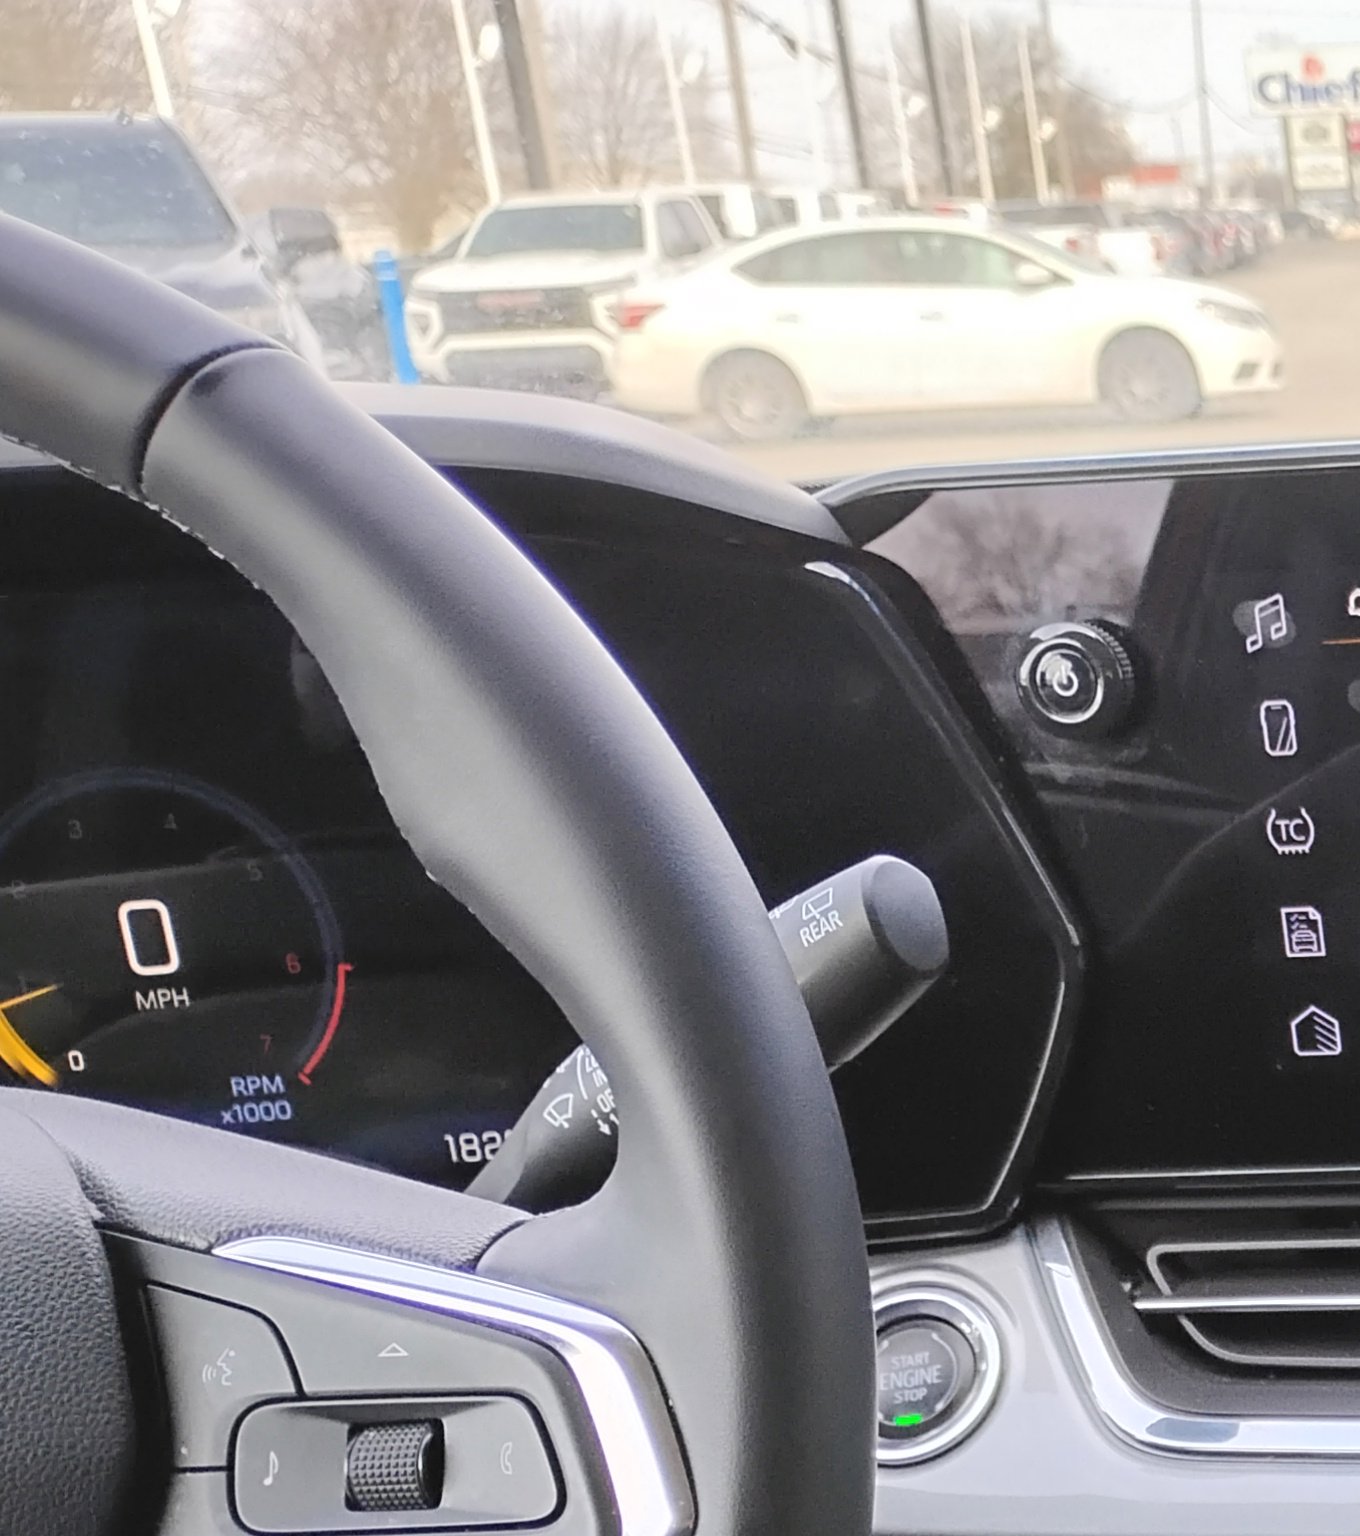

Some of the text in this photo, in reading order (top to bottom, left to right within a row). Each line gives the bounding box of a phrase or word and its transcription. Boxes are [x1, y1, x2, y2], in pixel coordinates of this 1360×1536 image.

[68, 820, 82, 839] 3
[1275, 819, 1306, 842] TC
[118, 899, 180, 976] 0
[799, 909, 843, 947] REAR
[286, 953, 301, 974] 6
[135, 987, 190, 1010] MPH
[67, 1050, 84, 1072] 0
[230, 1075, 285, 1097] RPM
[221, 1100, 292, 1124] x1000
[597, 1088, 616, 1113] OF
[443, 1129, 513, 1163] 182
[890, 1352, 930, 1370] START
[879, 1364, 943, 1391] ENGINE
[894, 1387, 928, 1404] STOP
